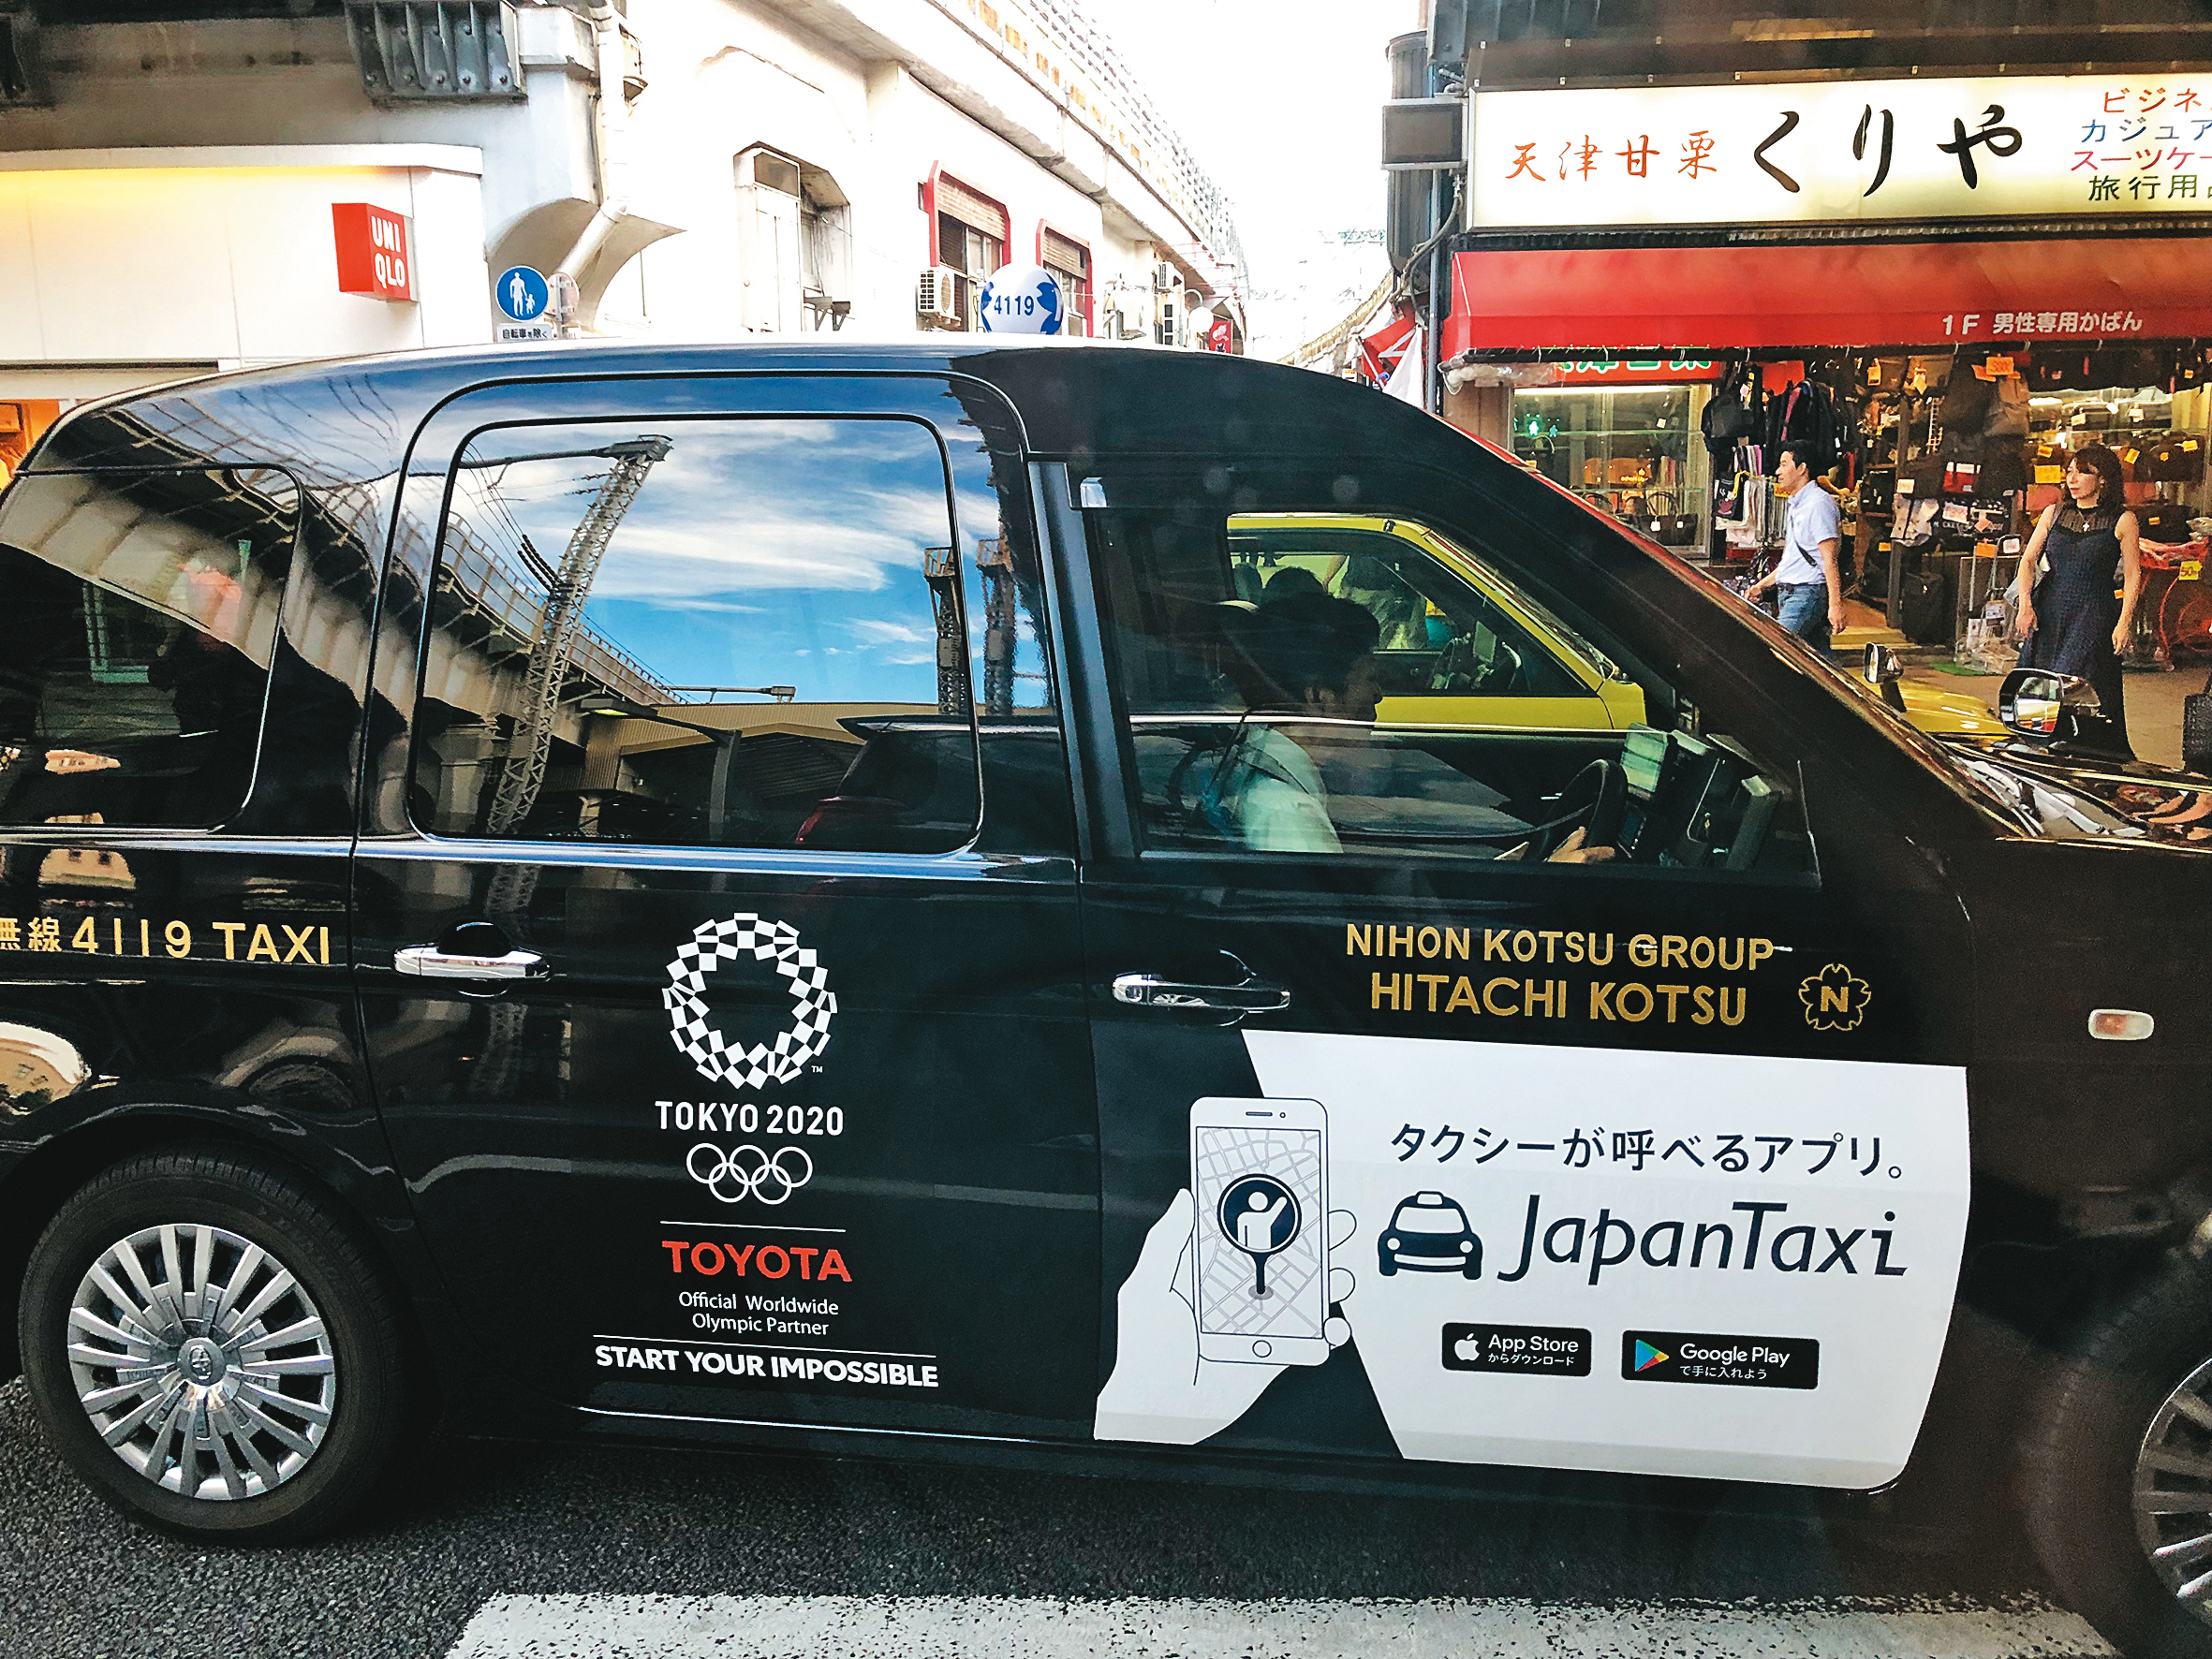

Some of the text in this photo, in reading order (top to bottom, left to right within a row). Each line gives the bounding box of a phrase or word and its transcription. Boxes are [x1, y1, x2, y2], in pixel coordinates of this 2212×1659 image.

[2103, 87, 2212, 113] ビジネ
[1505, 104, 2023, 198] 天津甘栗 くりや
[2088, 174, 2212, 201] 旅行用
[994, 295, 1035, 316] 4119
[1993, 311, 2143, 334] 男性専用かばん
[212, 921, 330, 965] TAXI
[1347, 924, 1775, 971] NIHON KOTSU GROUP
[1371, 972, 1746, 1026] HITACHI KOTSU
[1820, 986, 1848, 1013] N
[655, 1100, 843, 1136] TOKYO 2020
[1390, 1123, 1902, 1180] タクシーが呼べるアプリ。
[1497, 1194, 1908, 1286] JapanTaxi
[662, 1241, 852, 1283] TOYOTA
[679, 1291, 839, 1315] Official Worldwide
[692, 1313, 829, 1335] Olympic Partner
[1488, 1334, 1579, 1354] App Store
[1680, 1343, 1791, 1368] Google Play
[595, 1345, 938, 1387] START YOUR IMPOSSIBLE
[1488, 1354, 1575, 1367] からダウンロード
[1680, 1365, 1768, 1381] で手に入れよう
